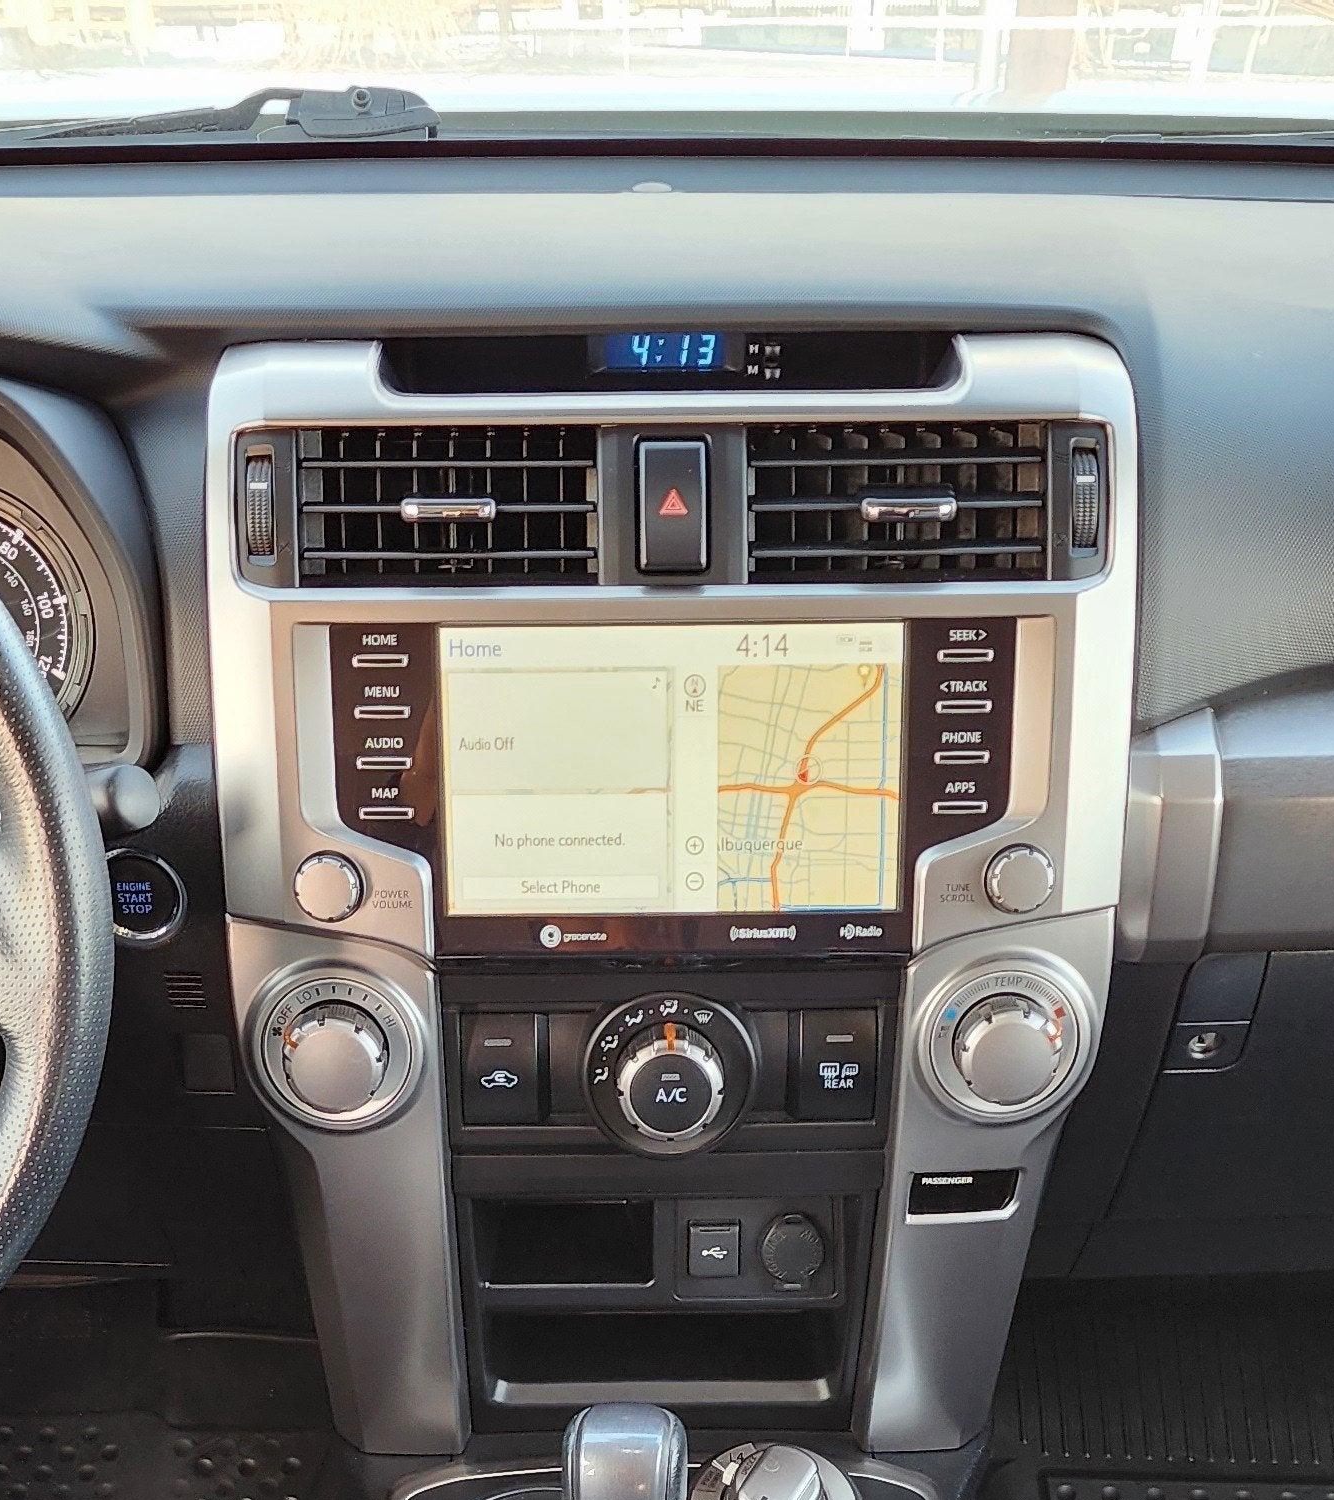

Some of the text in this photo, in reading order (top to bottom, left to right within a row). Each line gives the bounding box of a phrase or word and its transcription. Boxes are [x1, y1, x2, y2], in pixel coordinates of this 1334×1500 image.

[632, 334, 716, 367] 4:13
[36, 592, 54, 619] 100
[362, 634, 398, 646] HOME
[736, 633, 789, 658] 4:14
[448, 639, 503, 659] Home
[364, 686, 400, 698] MENU
[685, 700, 705, 712] NE
[365, 737, 404, 749] AUDIO
[459, 736, 515, 751] Audio Off
[941, 731, 982, 744] PHONE
[371, 787, 399, 799] MAP
[945, 782, 976, 794] APPS
[494, 832, 626, 851] No phone connected.
[116, 882, 152, 891] ENGINE
[521, 879, 601, 895] Select Phone
[945, 883, 970, 892] TUNE
[118, 893, 153, 903] START
[374, 889, 409, 899] POWER
[940, 894, 974, 903] SCROLL
[122, 904, 153, 914] STOP
[372, 900, 413, 909] VOLUME
[856, 925, 883, 938] Radio
[995, 976, 1023, 987] TEMP
[296, 990, 312, 1005] LO
[277, 1004, 293, 1025] OFF
[383, 1015, 397, 1028] HI
[824, 1079, 854, 1089] REAR
[656, 1088, 688, 1103] A/C
